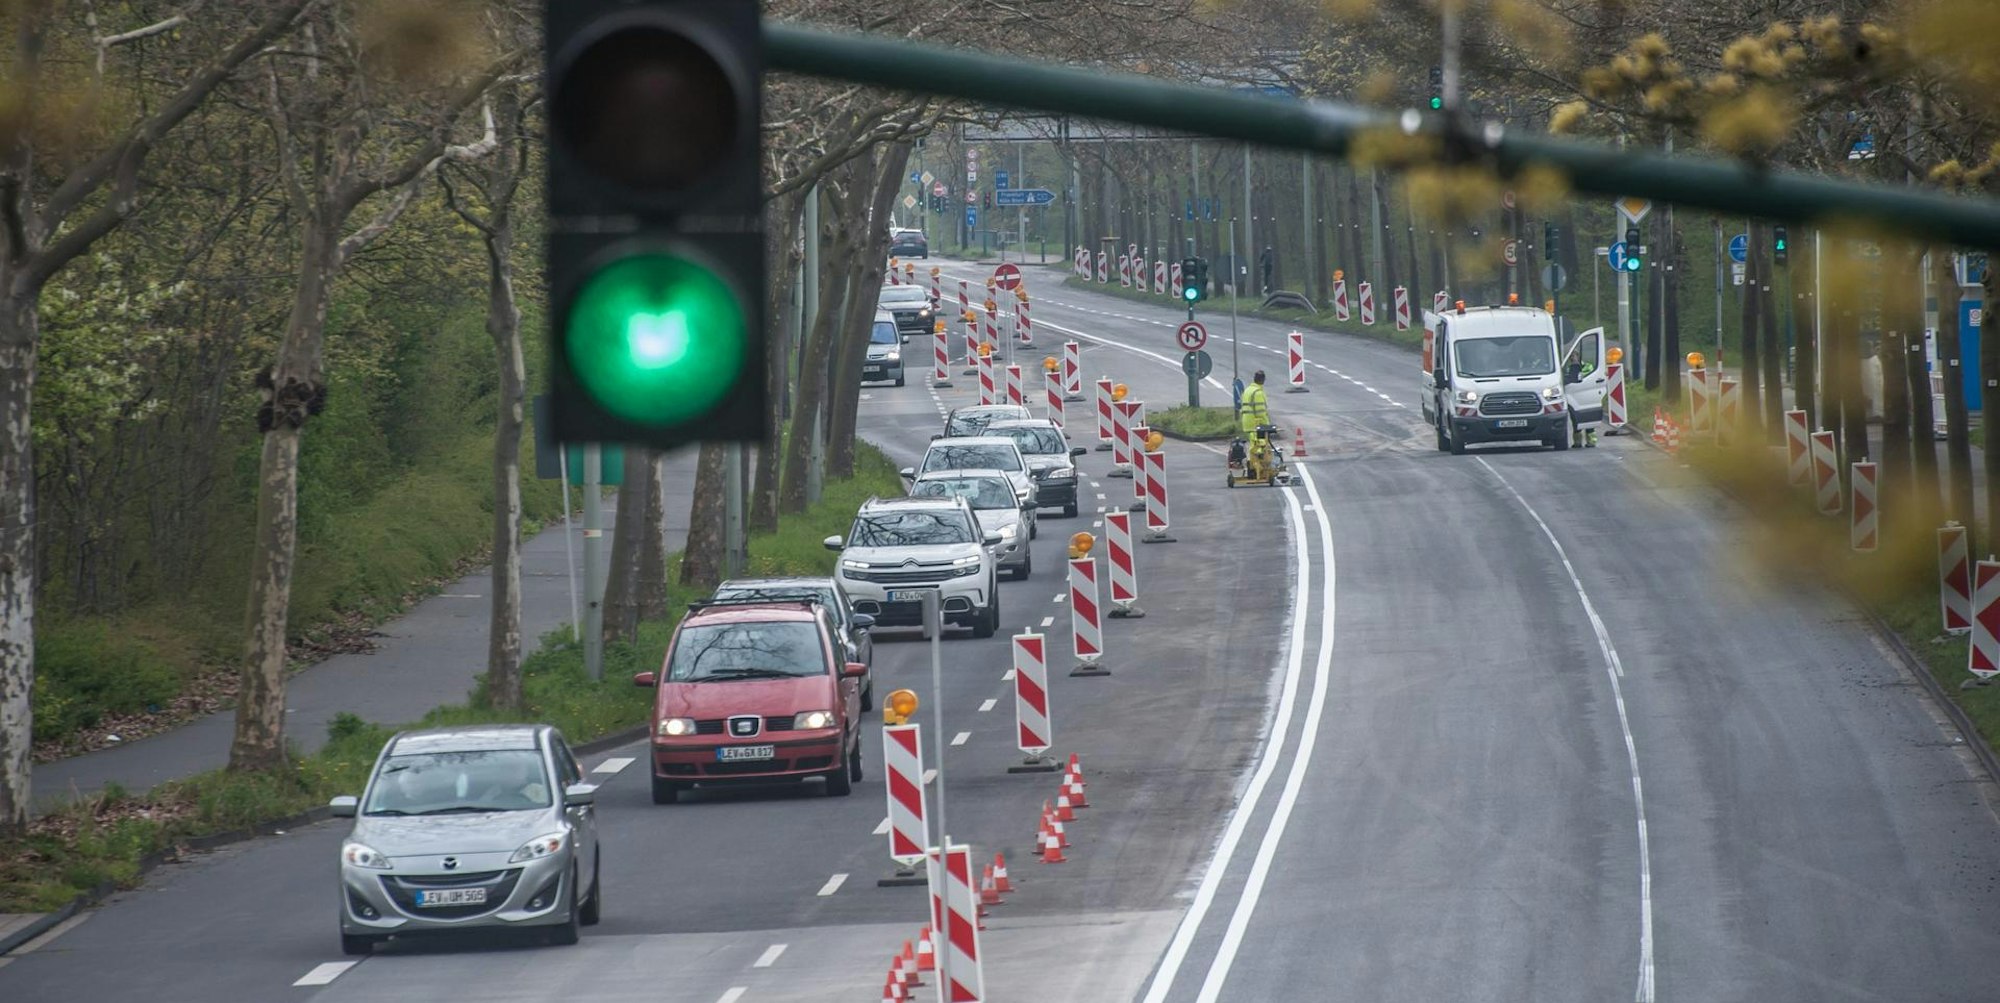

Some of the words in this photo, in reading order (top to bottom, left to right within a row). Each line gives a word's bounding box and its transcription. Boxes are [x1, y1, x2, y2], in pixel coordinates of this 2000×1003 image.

[722, 749, 738, 758] LEV
[423, 891, 442, 903] LEV
[449, 891, 462, 902] UH
